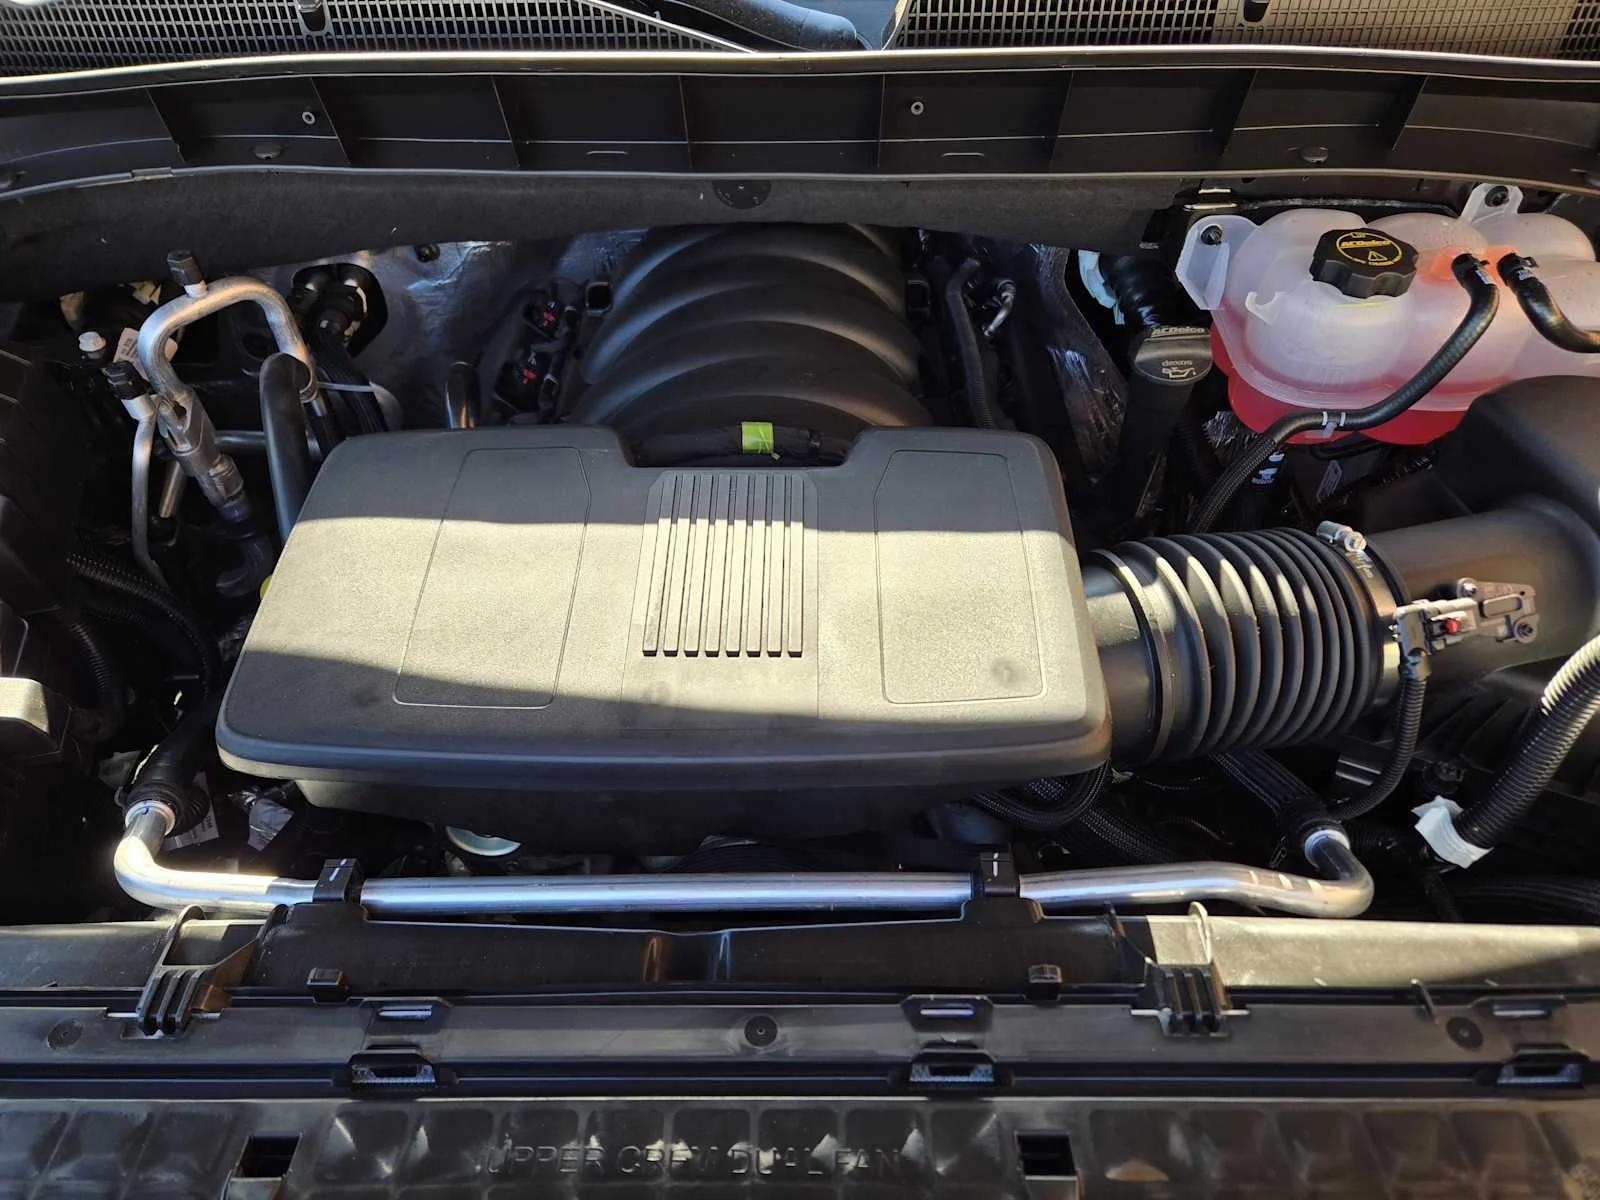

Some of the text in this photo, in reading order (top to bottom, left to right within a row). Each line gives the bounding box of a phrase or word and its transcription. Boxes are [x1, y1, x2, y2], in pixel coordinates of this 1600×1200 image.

[1151, 326, 1206, 338] ACDelco
[487, 1145, 605, 1174] UPPER
[730, 1146, 824, 1175] DUAL
[834, 1148, 901, 1176] FAN
